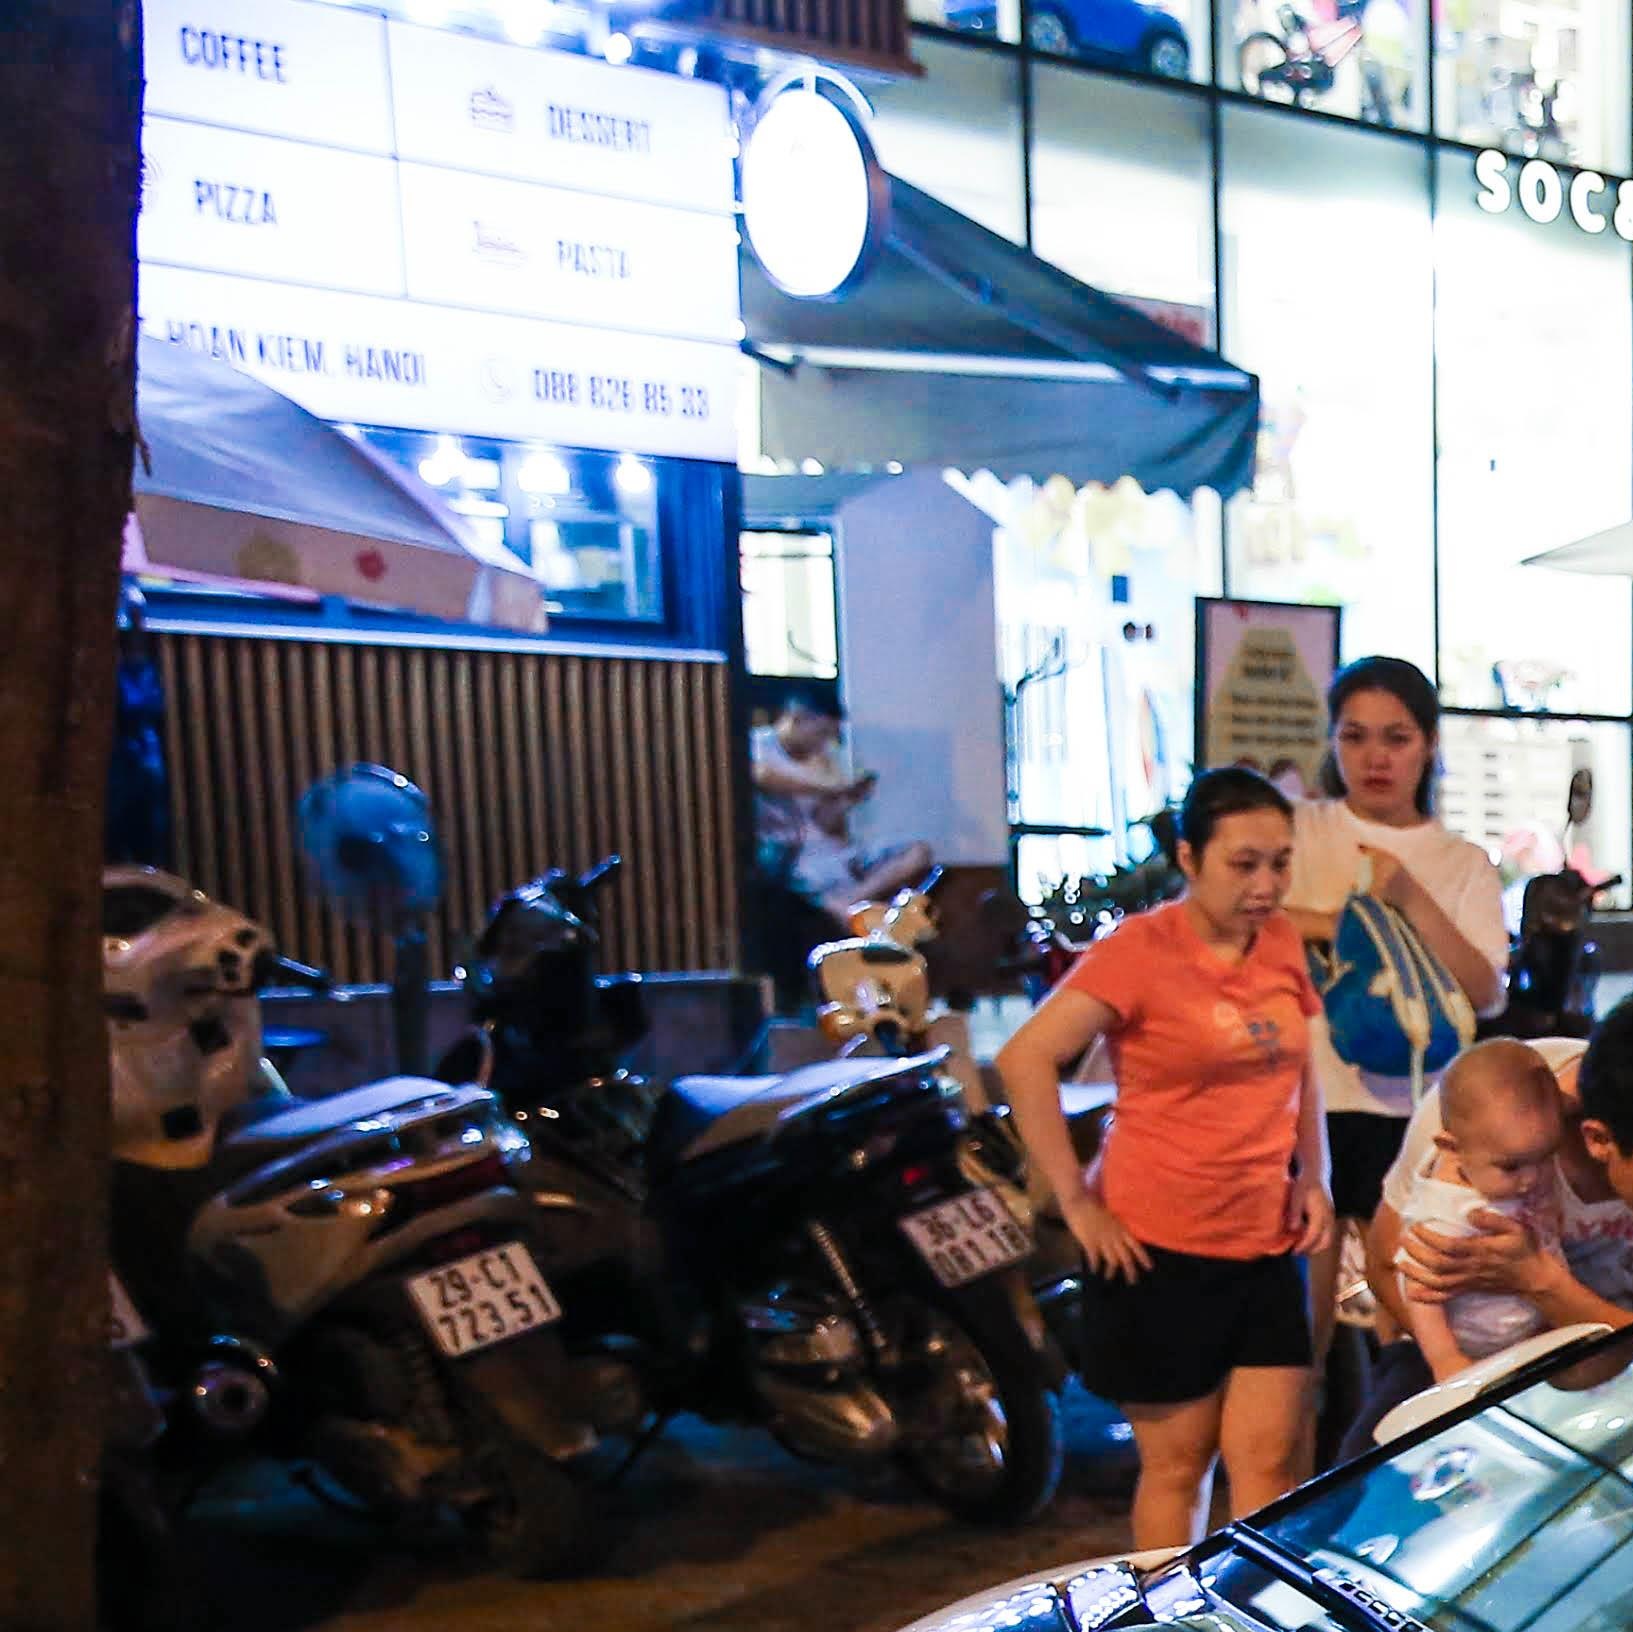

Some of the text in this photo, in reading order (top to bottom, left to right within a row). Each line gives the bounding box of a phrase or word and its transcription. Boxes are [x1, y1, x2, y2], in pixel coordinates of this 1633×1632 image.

[179, 25, 288, 84] COFFEE
[547, 104, 652, 153] DESSERT
[194, 180, 278, 226] PIZZA
[556, 239, 632, 280] PASTA
